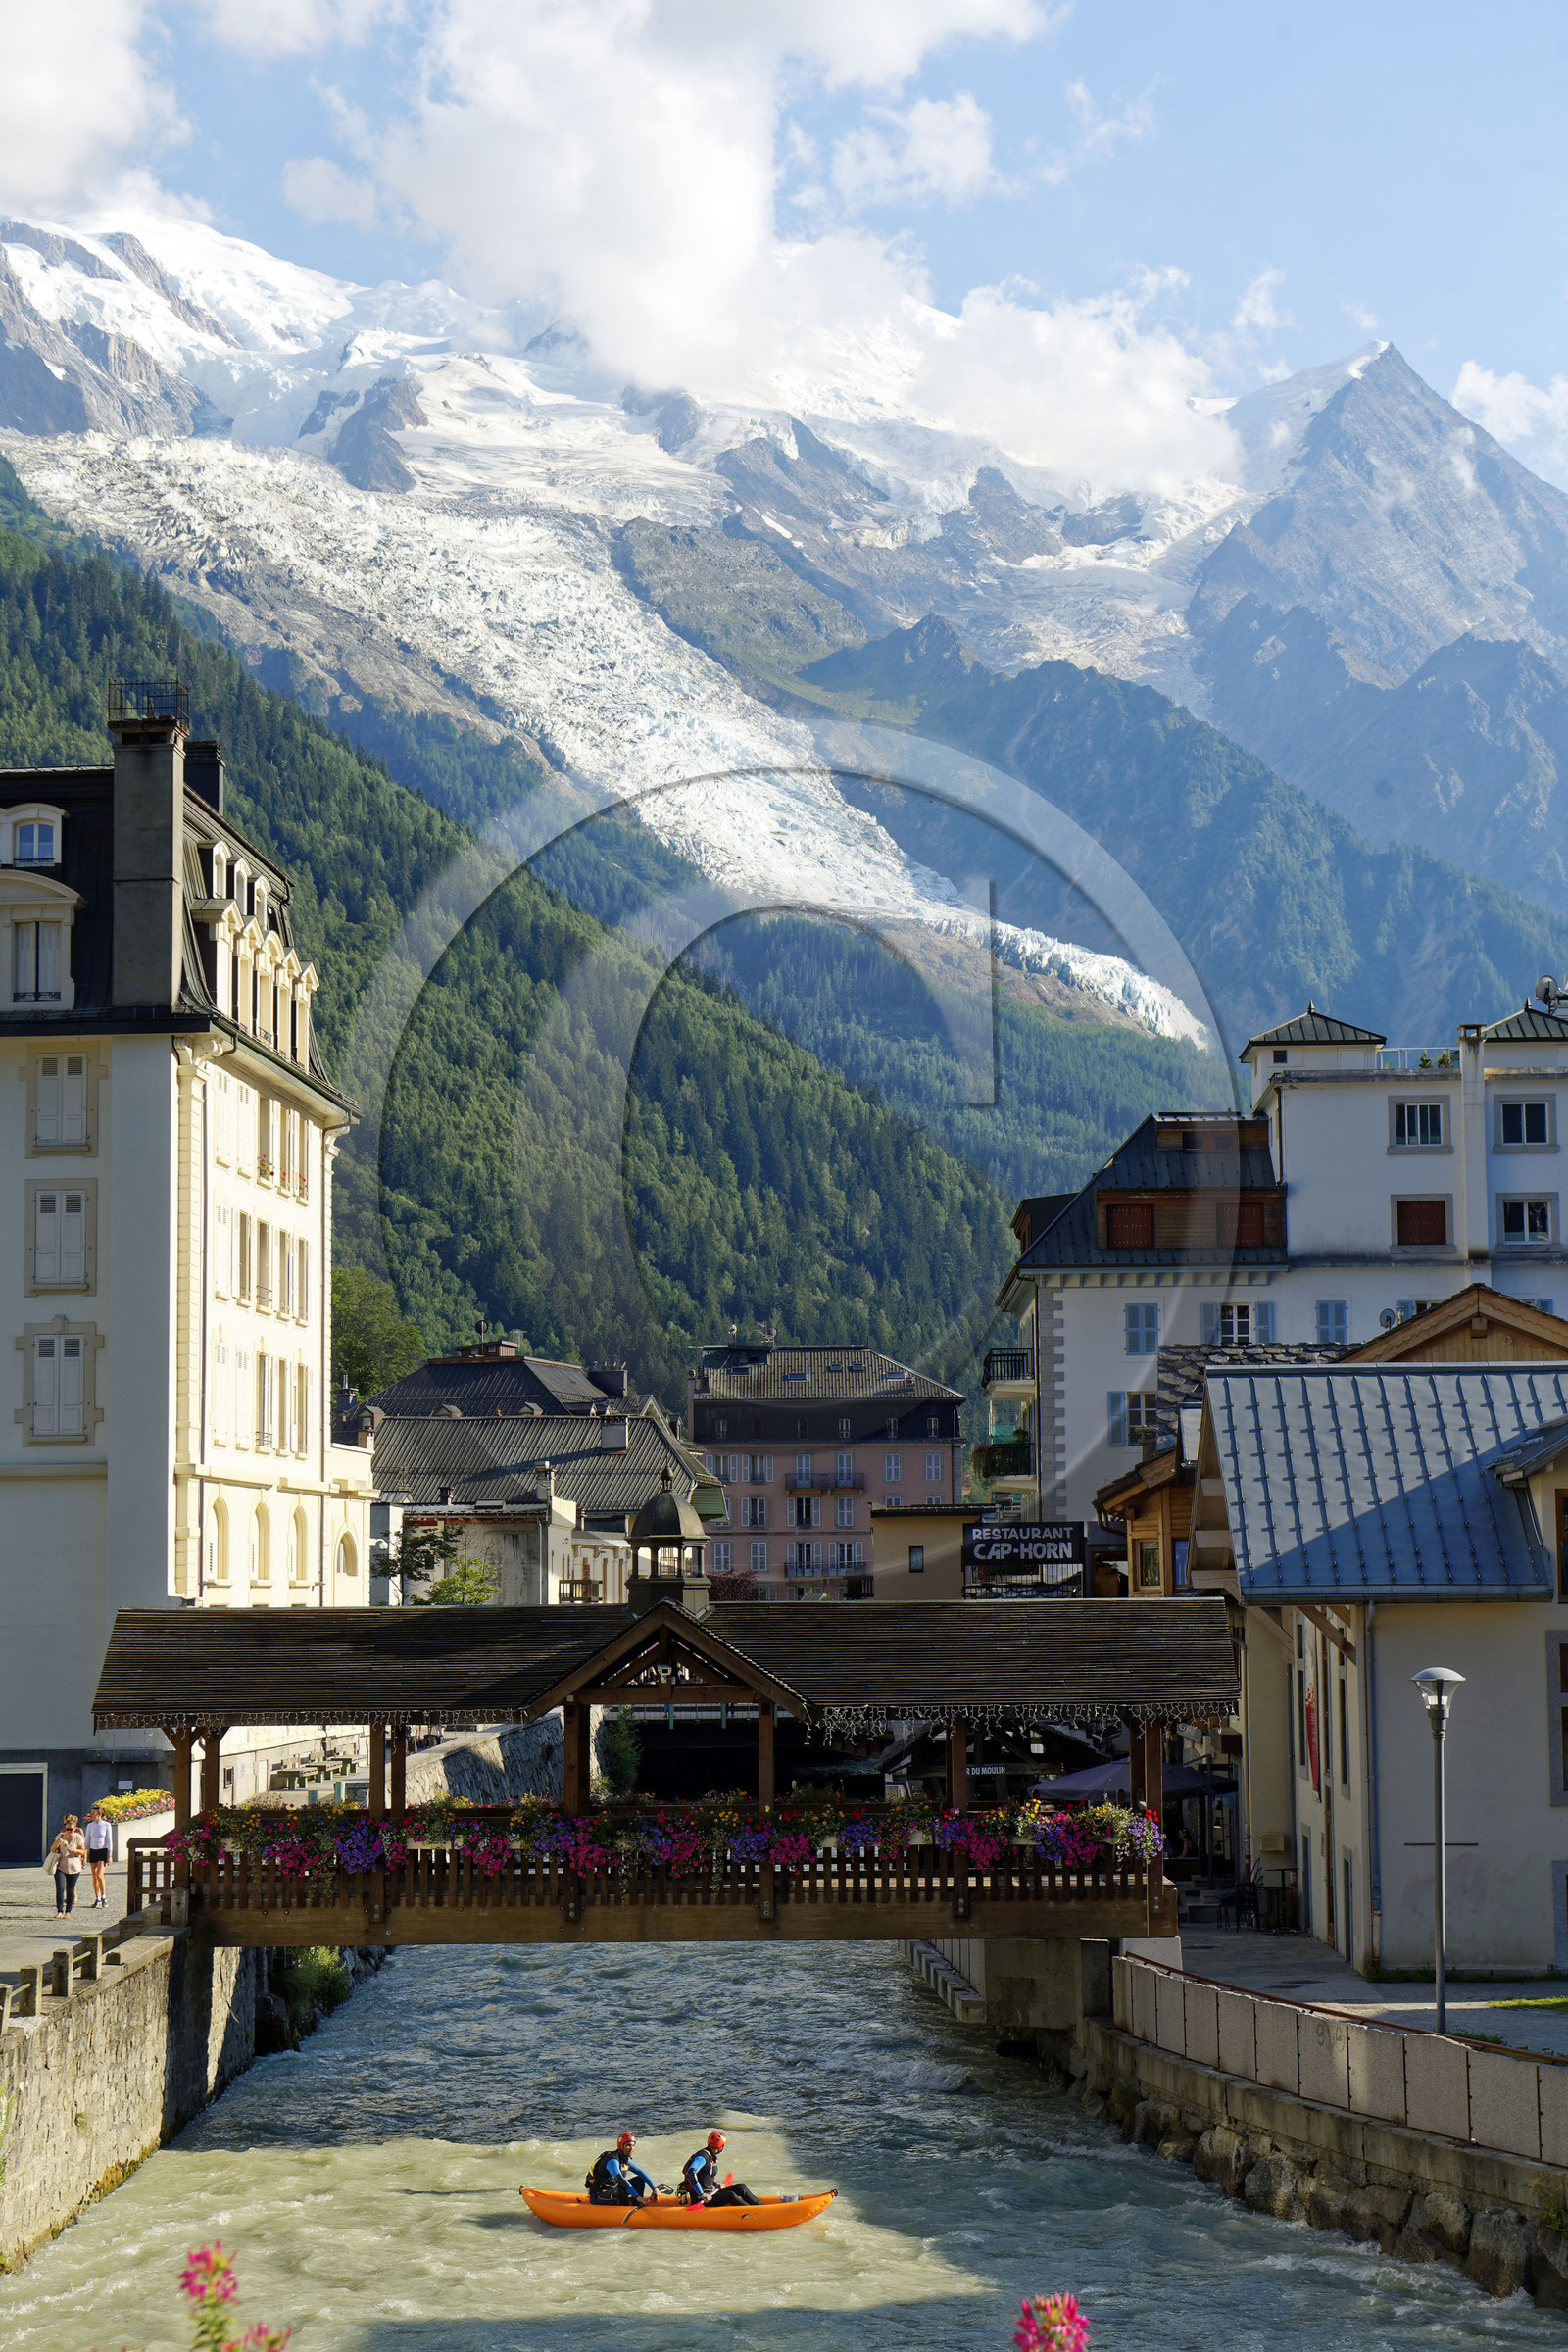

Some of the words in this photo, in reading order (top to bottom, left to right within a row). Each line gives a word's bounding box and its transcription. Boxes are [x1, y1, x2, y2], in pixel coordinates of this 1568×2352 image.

[972, 1527, 1073, 1540] RESTAURANT
[973, 1542, 1073, 1560] CAP-HORN
[981, 1766, 1005, 1775] MOULIN
